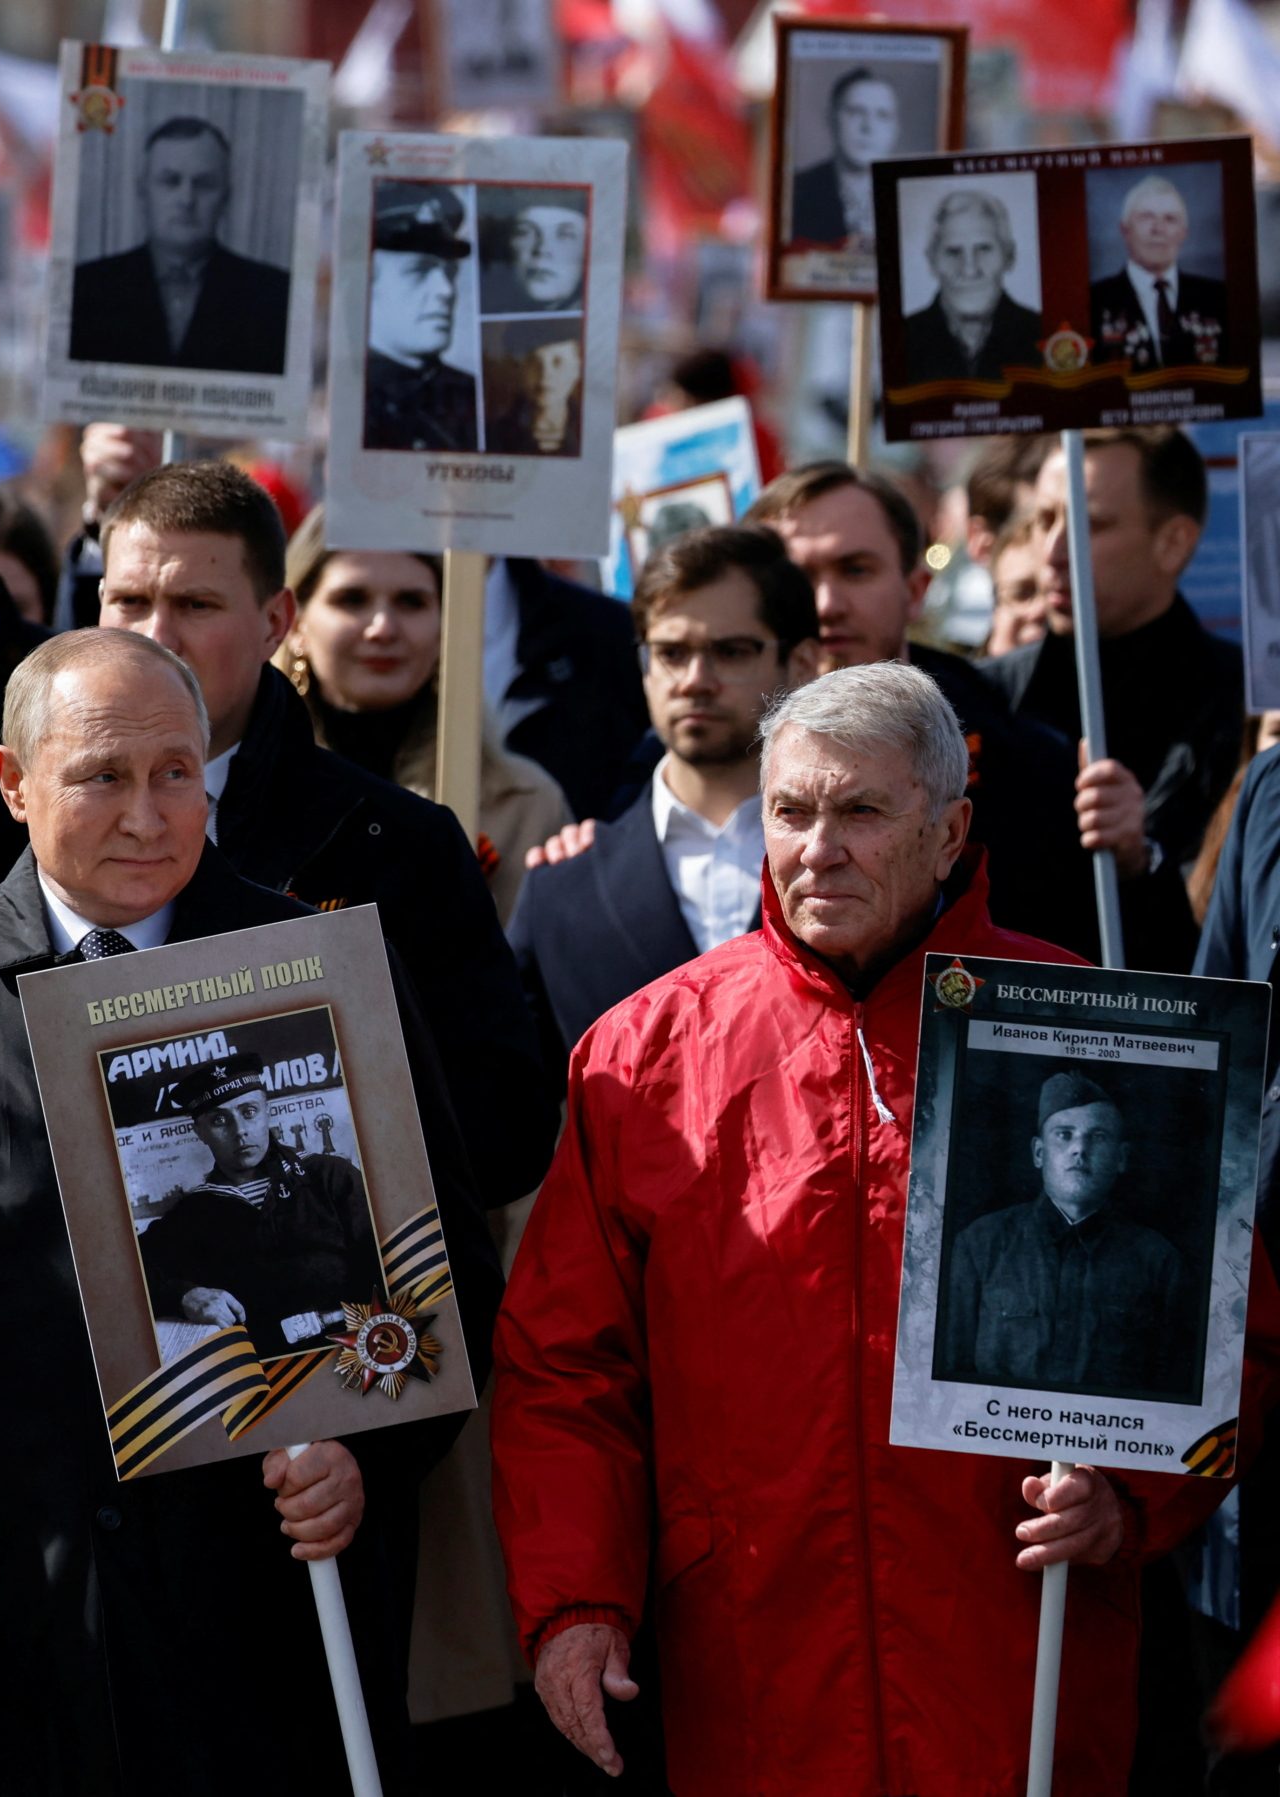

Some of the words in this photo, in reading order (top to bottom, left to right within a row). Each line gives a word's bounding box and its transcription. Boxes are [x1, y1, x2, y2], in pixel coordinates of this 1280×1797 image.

[86, 965, 255, 1026] БЕССМЕРТНЫЙ
[260, 955, 324, 990] ПОЛК
[997, 984, 1137, 1010] БЕССМЕРТНЫЙ
[1143, 998, 1198, 1016] ПОЛК
[993, 1024, 1048, 1041] Иванов
[1053, 1030, 1109, 1047] Кирилл
[1113, 1035, 1195, 1055] Матвеевич
[1065, 1047, 1087, 1056] 1915
[1098, 1049, 1120, 1059] 2003
[213, 1078, 243, 1096] ОТРЯД
[358, 1315, 408, 1370] ОТЕЧЕСТВЕННАЯ
[402, 1329, 416, 1365] ВОЙНА
[986, 1400, 1001, 1416] С
[1007, 1405, 1053, 1421] него
[1059, 1410, 1144, 1431] начался
[952, 1421, 1108, 1451] «Бессмертный
[1114, 1439, 1175, 1457] полк»
